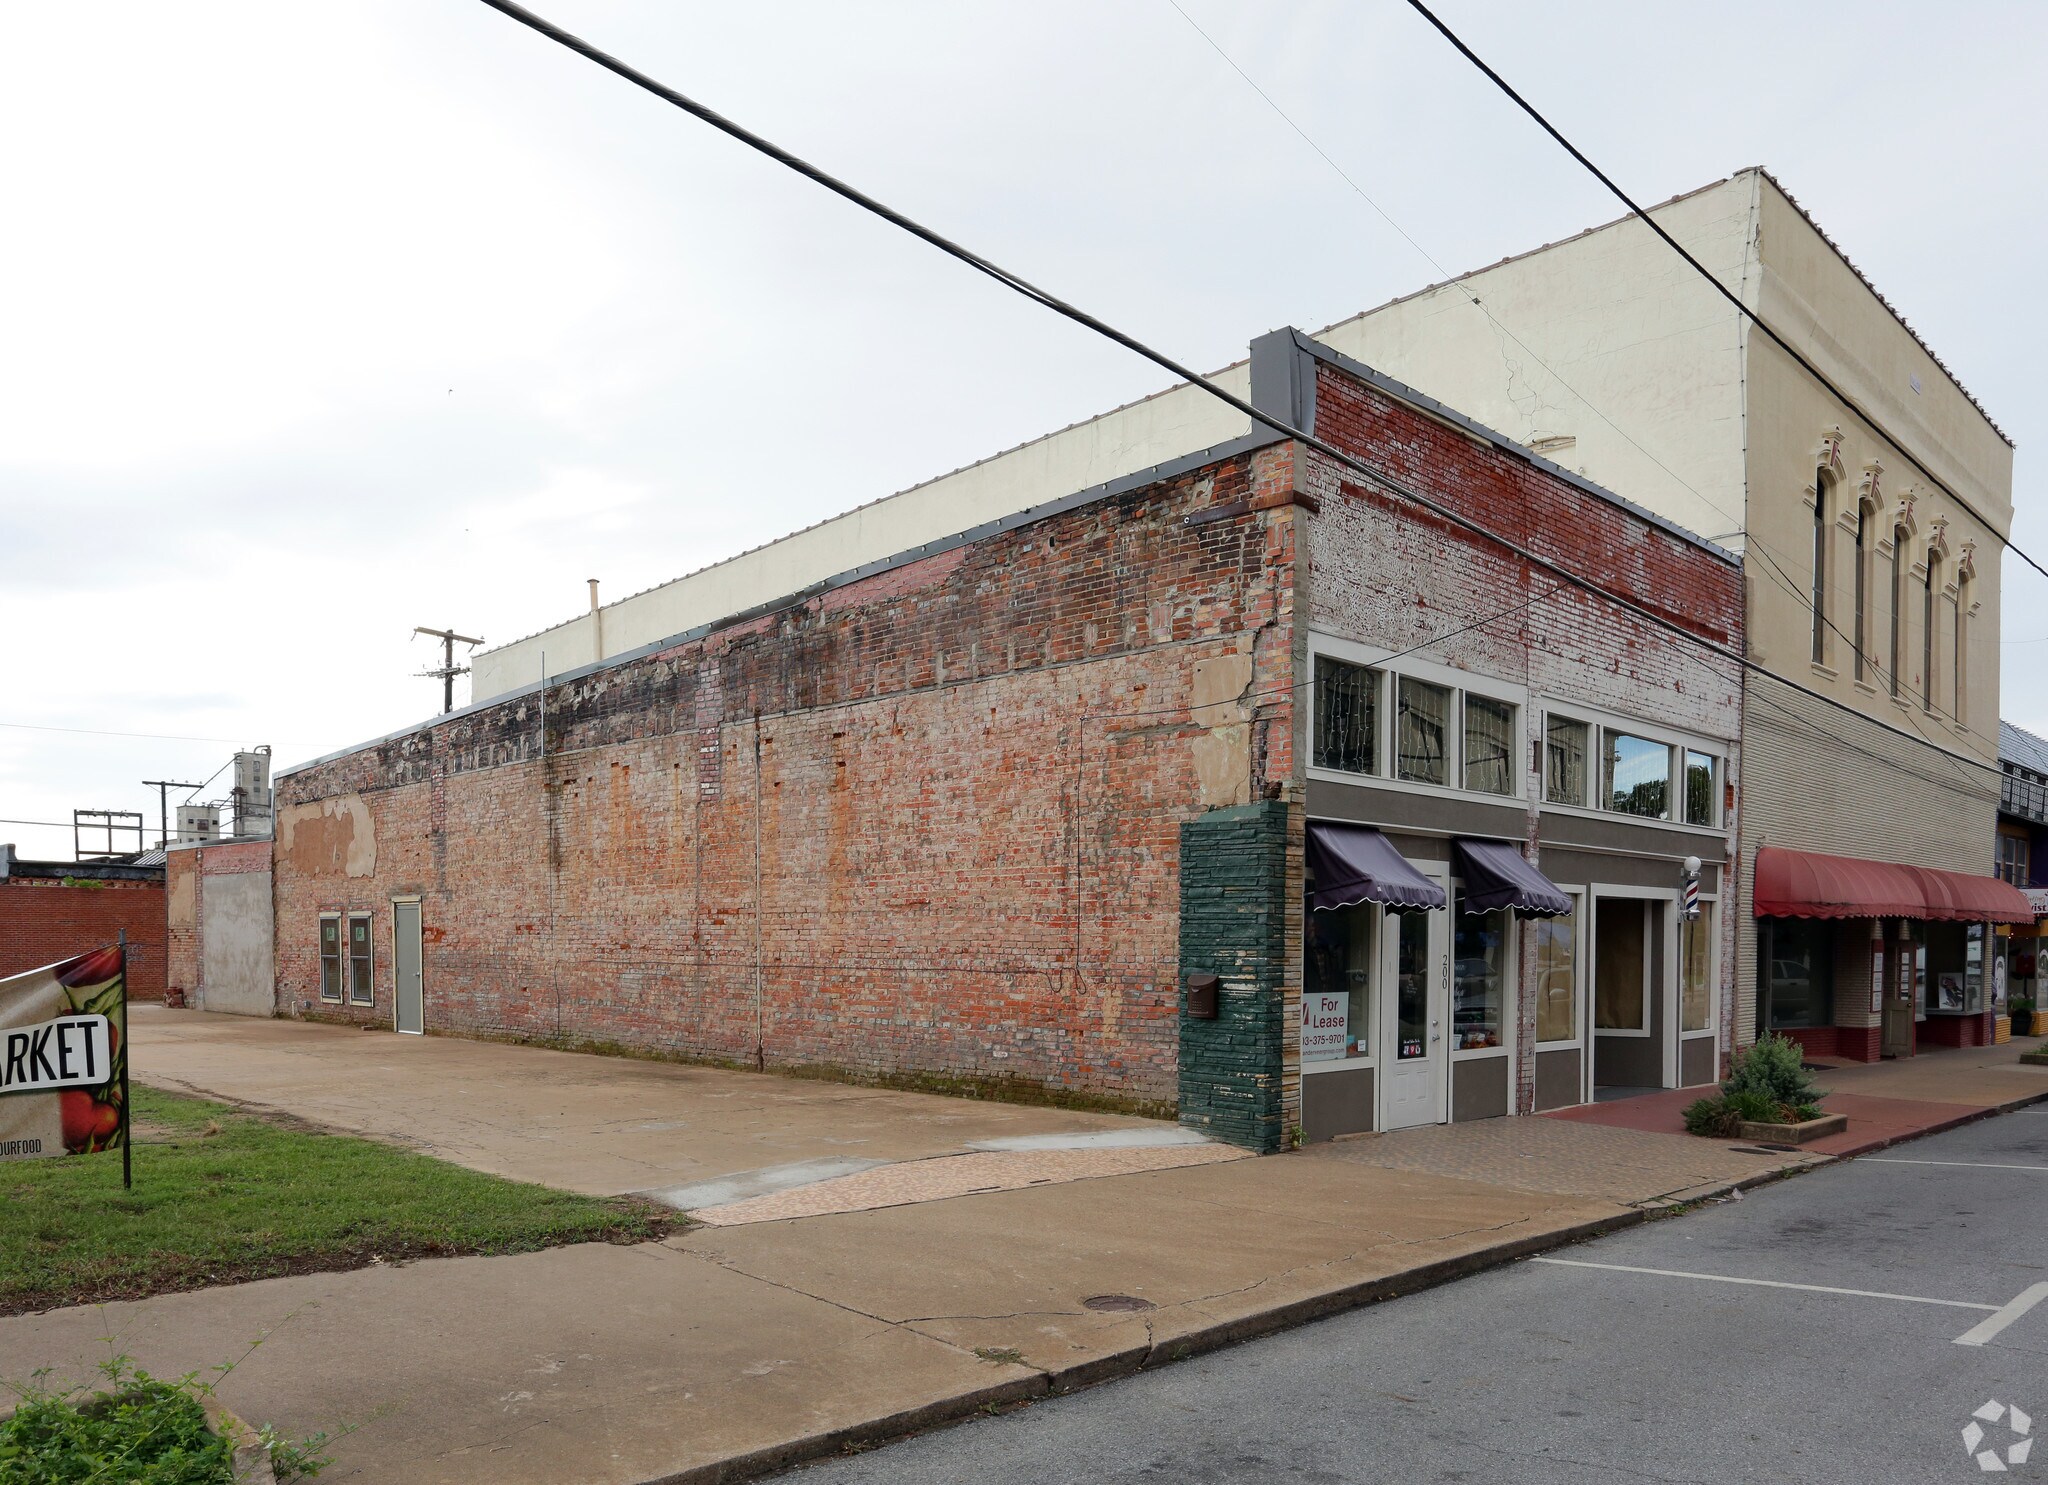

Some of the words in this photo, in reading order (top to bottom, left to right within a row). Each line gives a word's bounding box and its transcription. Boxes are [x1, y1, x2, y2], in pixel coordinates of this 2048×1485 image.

[1321, 998, 1339, 1011] For
[1313, 1015, 1345, 1028] Lease
[0, 1021, 98, 1087] RKET
